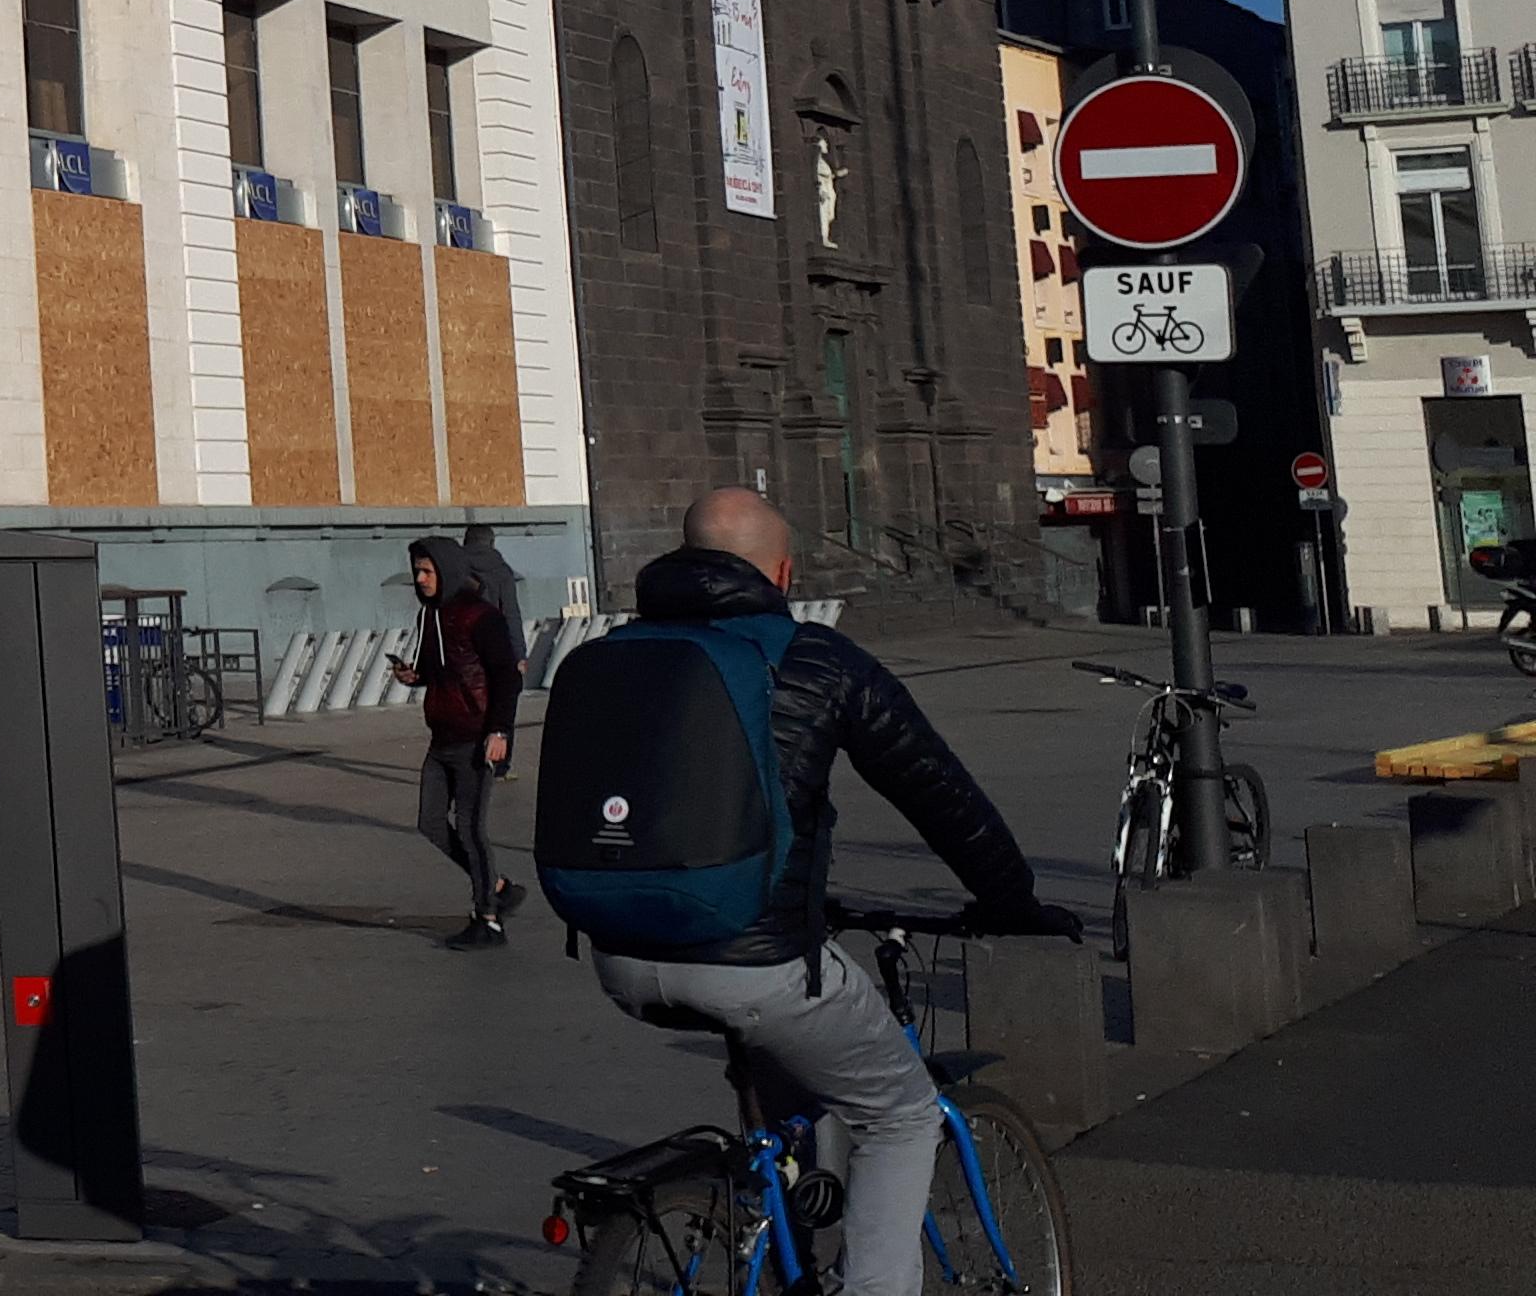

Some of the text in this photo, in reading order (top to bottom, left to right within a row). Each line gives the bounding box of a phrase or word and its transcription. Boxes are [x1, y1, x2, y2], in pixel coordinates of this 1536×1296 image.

[59, 152, 87, 176] LCL
[250, 182, 274, 204] LCL
[1117, 271, 1193, 295] SAUF
